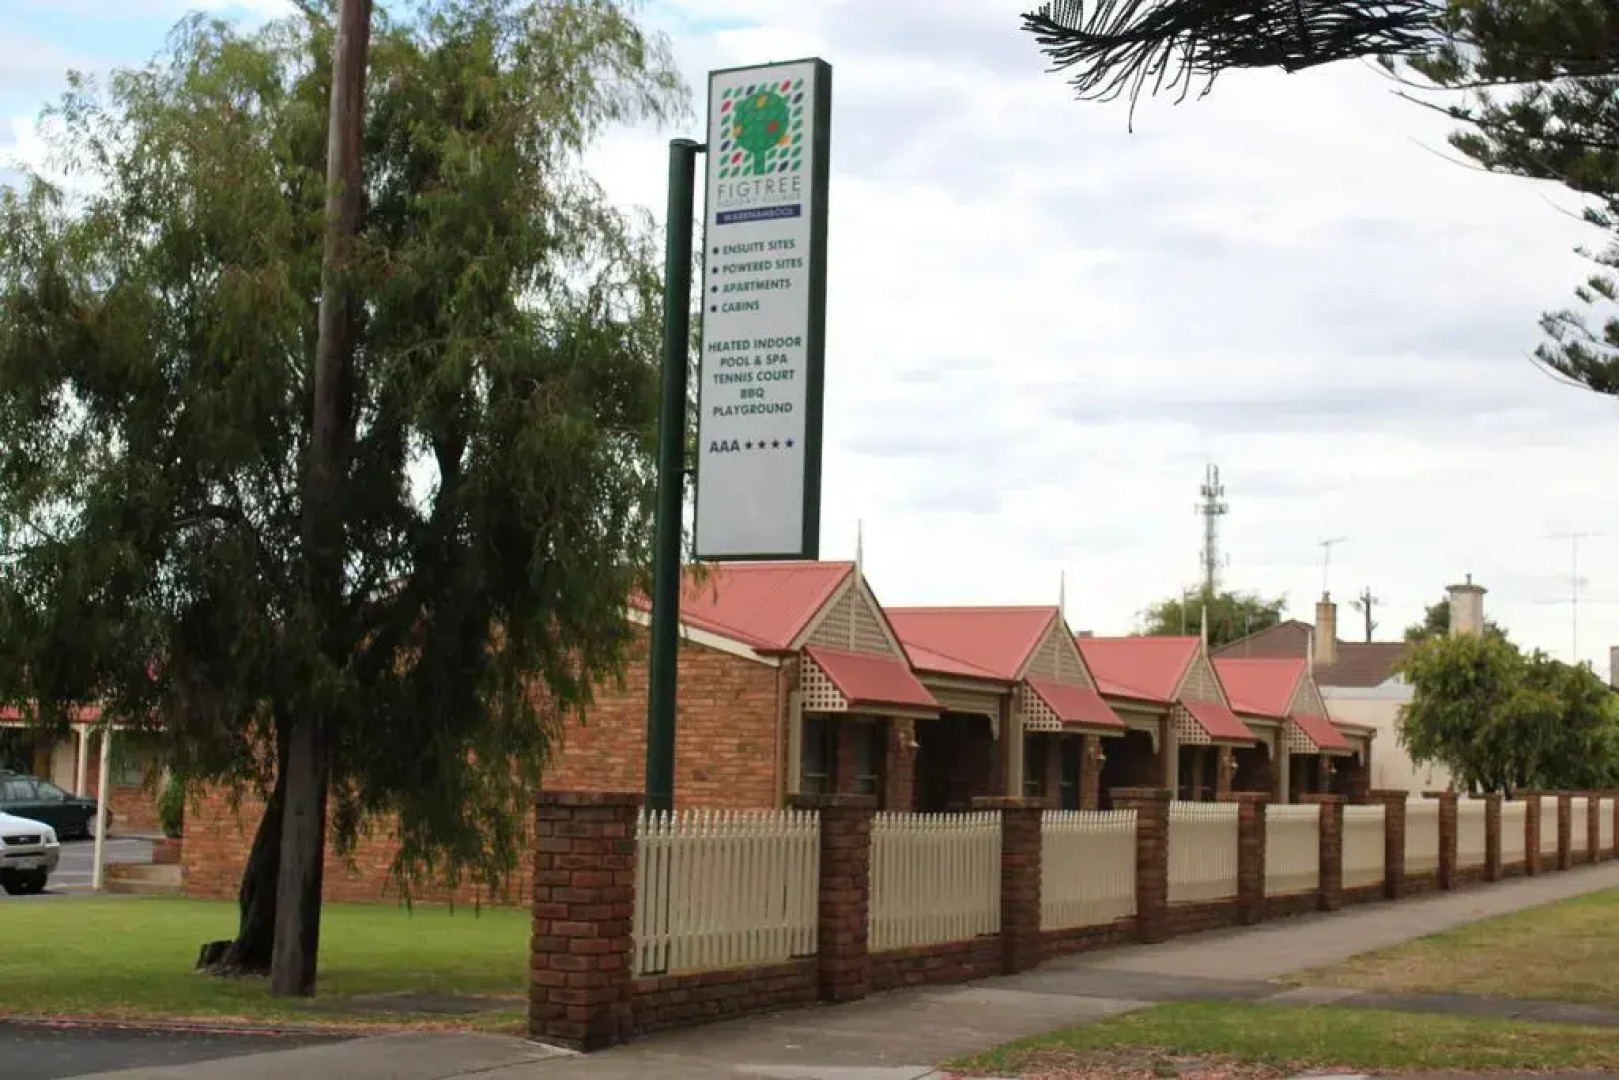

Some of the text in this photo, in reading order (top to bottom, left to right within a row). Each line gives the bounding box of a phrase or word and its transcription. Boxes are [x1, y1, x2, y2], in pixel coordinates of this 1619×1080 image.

[718, 176, 801, 200] FIGTREE
[723, 238, 796, 255] ENSUITE SITES
[722, 258, 803, 274] POWERED SITES
[722, 278, 792, 293] APARTMENTS
[722, 300, 760, 313] CABINS
[708, 336, 802, 353] HEATED INDOOR
[720, 354, 788, 368] POOL & SPA
[713, 369, 794, 384] TENNIS COURT
[740, 386, 765, 400] BBQ
[712, 402, 792, 417] PLAYGROUND
[709, 440, 740, 454] AAA
